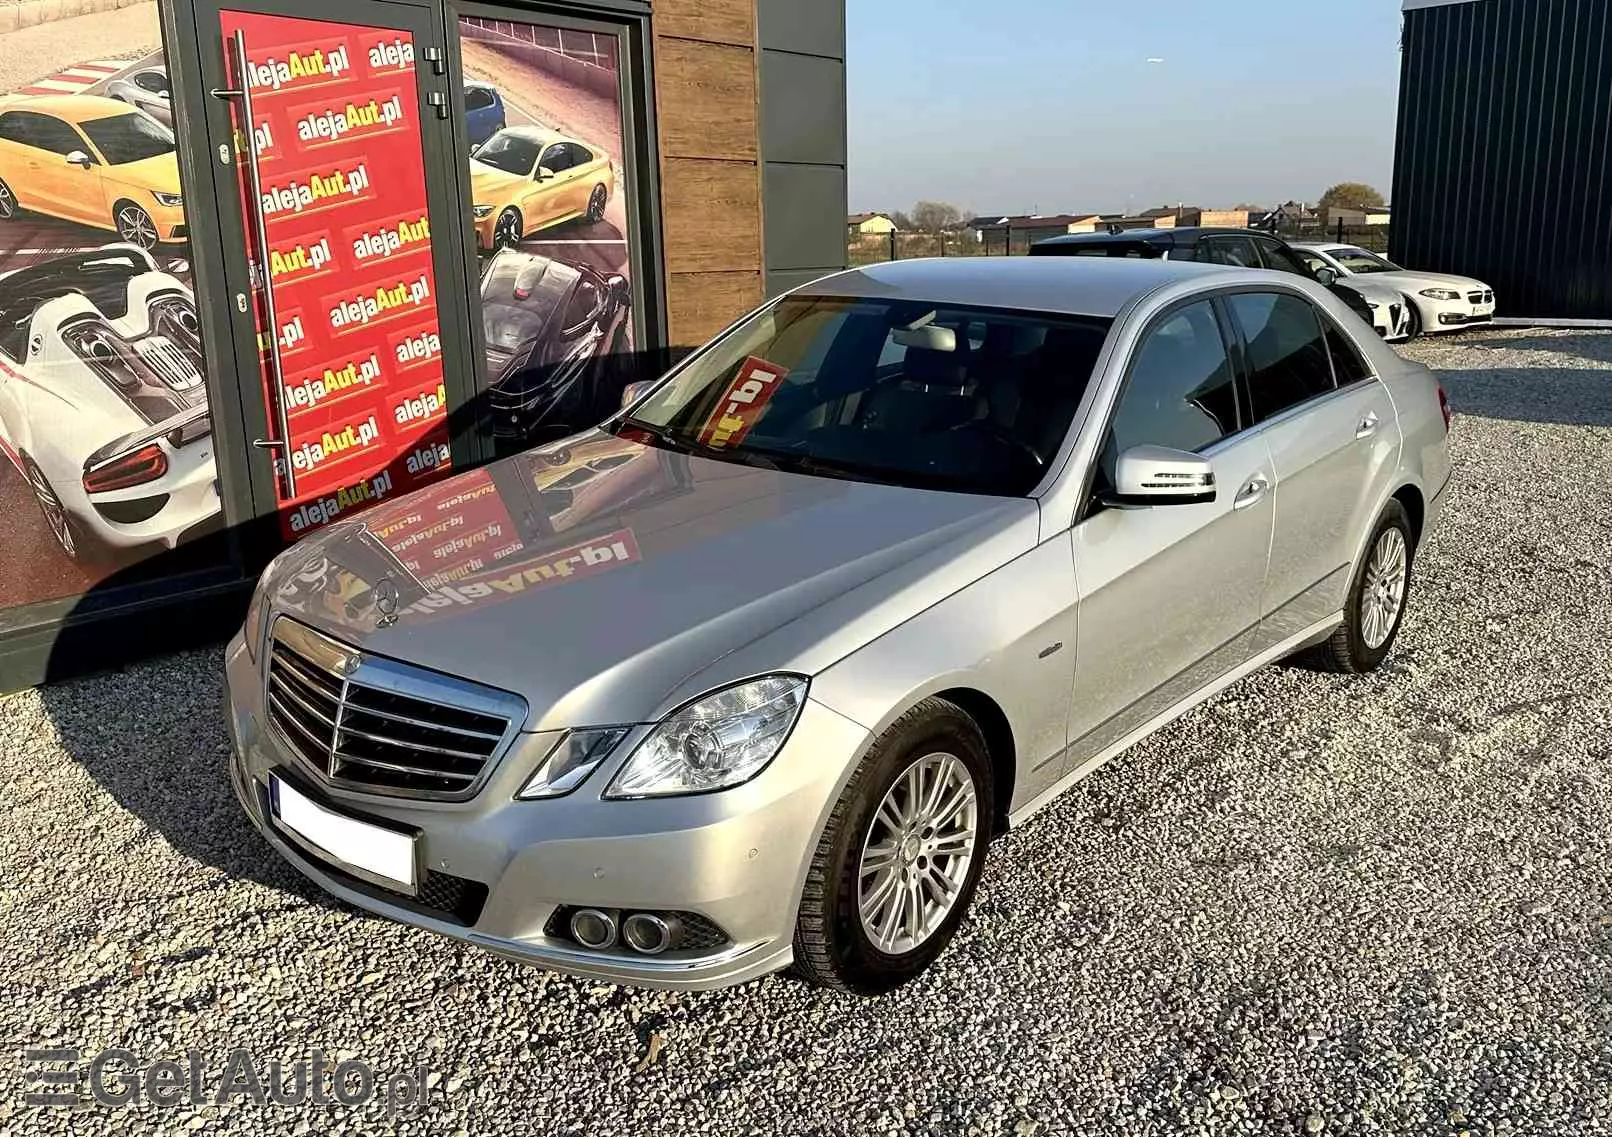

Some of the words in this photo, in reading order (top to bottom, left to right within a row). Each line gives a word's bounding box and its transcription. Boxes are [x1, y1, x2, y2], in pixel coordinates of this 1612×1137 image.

[297, 94, 402, 141] alejaAut.pl
[262, 163, 369, 214] alejaAut.pl
[329, 274, 430, 328] alejaAut.pl
[289, 470, 392, 532] alejaAut.pl
